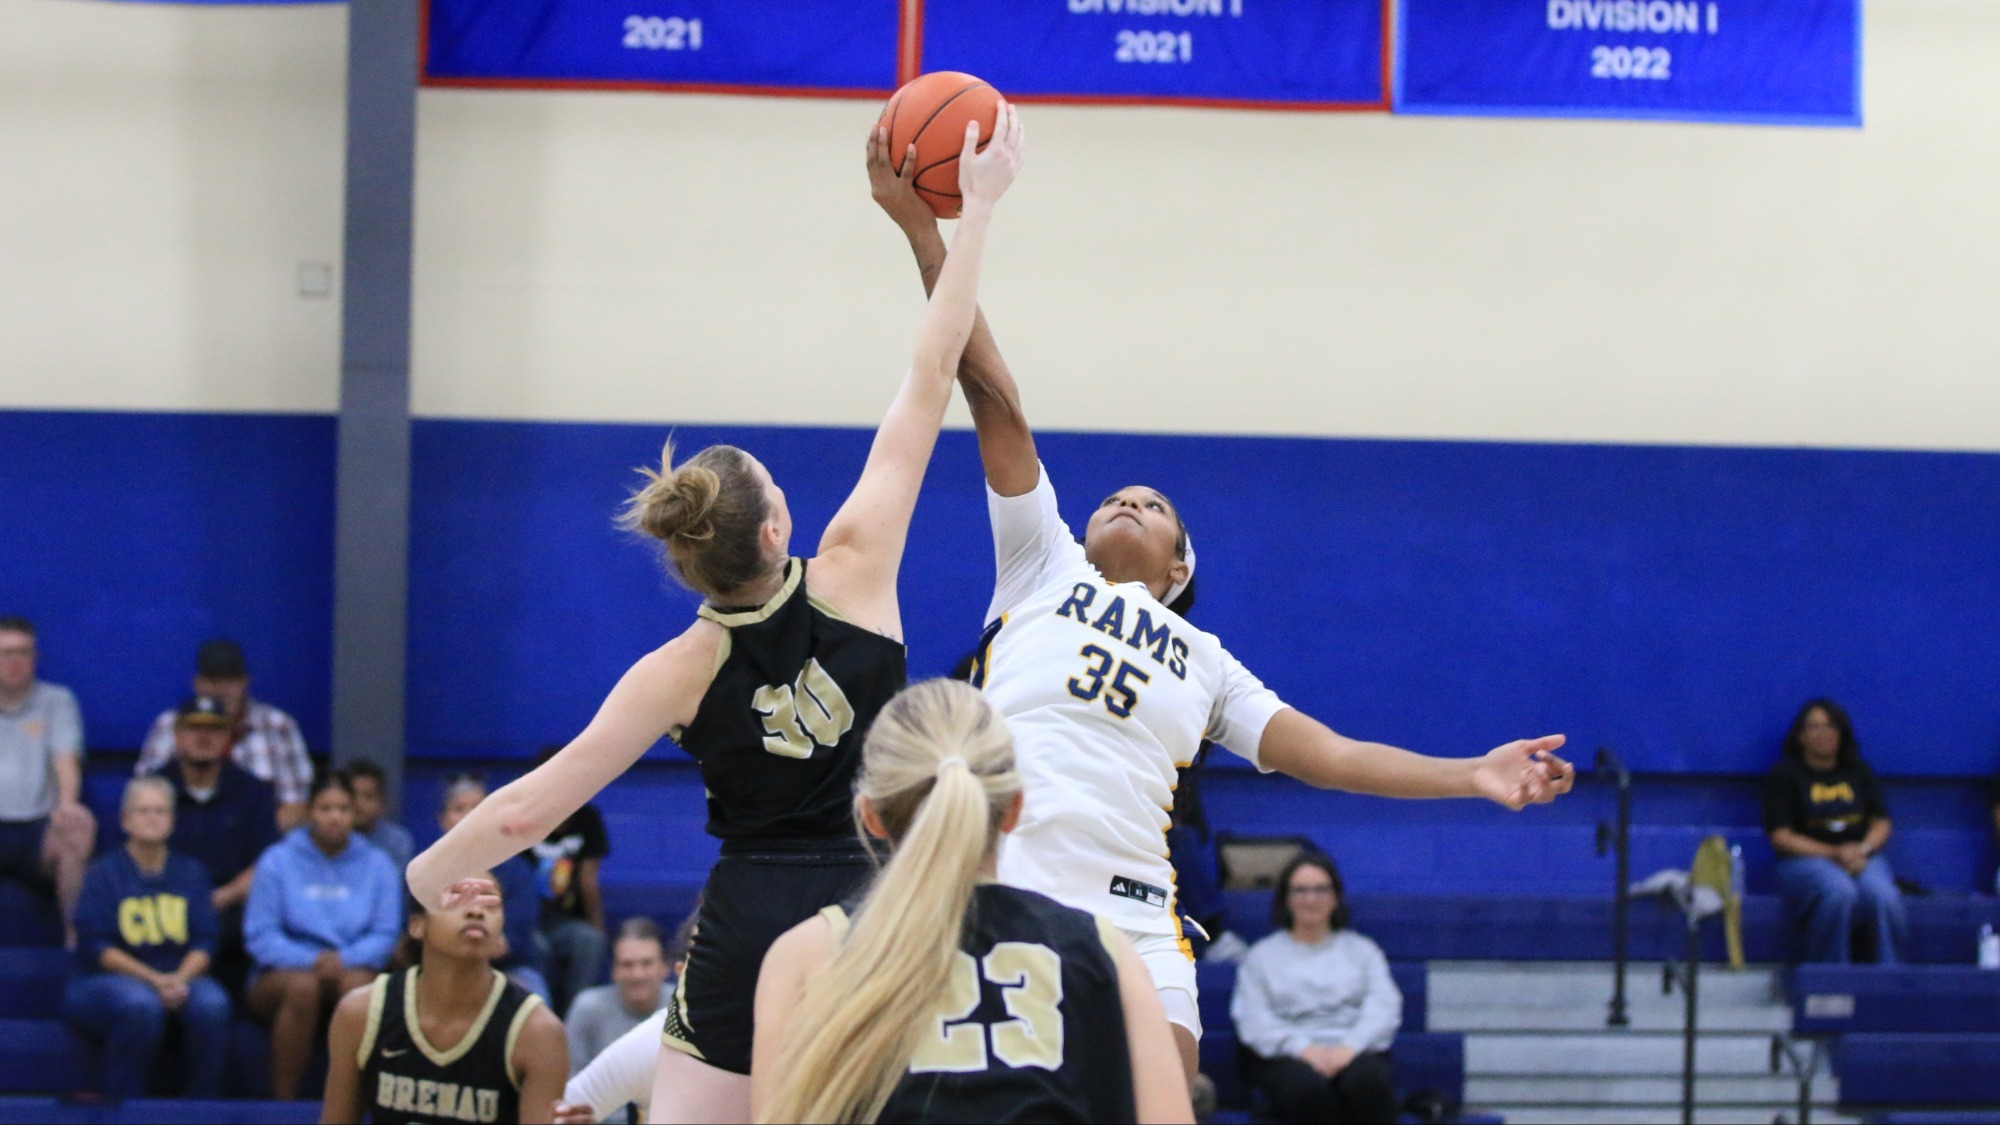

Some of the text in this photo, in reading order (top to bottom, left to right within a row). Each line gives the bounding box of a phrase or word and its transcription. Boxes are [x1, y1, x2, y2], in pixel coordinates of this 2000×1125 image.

[622, 15, 702, 50] 2021
[1547, 0, 1698, 33] DIVISION
[1115, 29, 1192, 63] 2021
[1591, 45, 1671, 80] 2022
[1055, 581, 1189, 681] RAMS
[1066, 643, 1151, 720] 35
[751, 657, 855, 759] 30
[909, 941, 1064, 1074] 23
[377, 1071, 499, 1122] BRENAU
